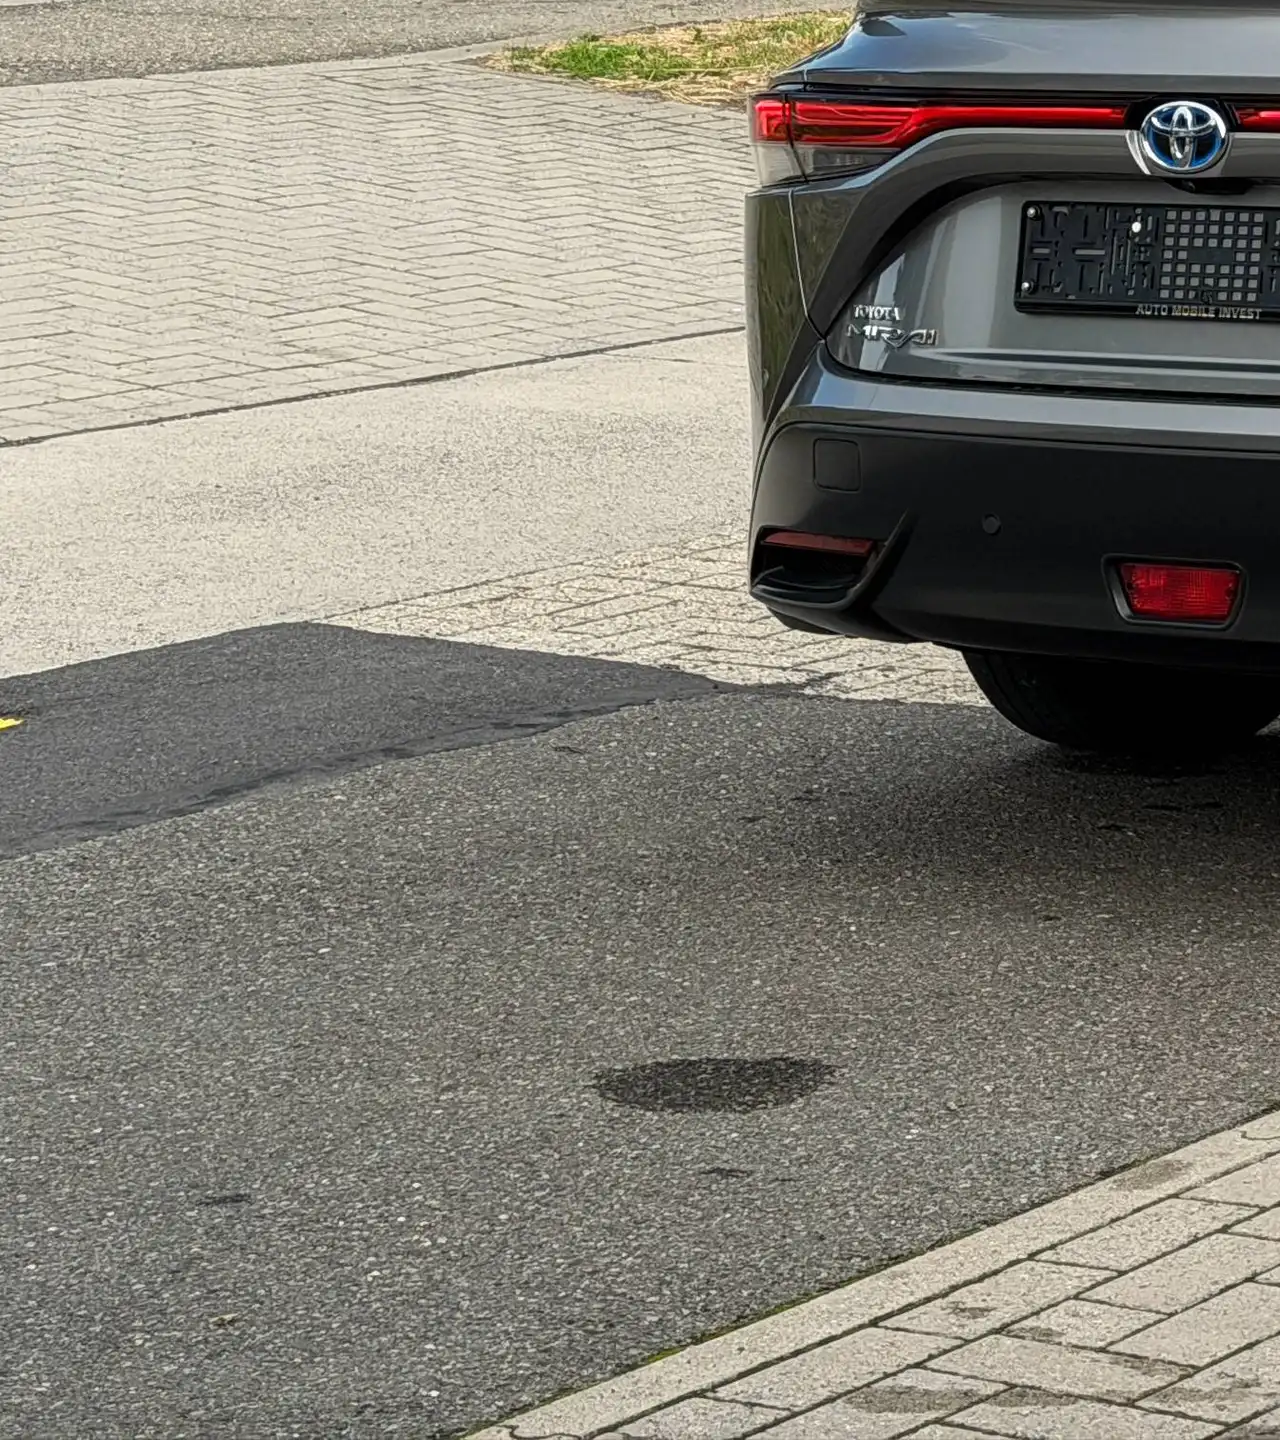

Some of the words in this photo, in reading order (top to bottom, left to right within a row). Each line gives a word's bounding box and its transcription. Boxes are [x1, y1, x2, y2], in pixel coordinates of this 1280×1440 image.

[853, 304, 901, 321] TOYOTA
[1135, 303, 1169, 316] AUTO
[1171, 304, 1216, 318] MOBILE
[1218, 306, 1262, 320] INVEST
